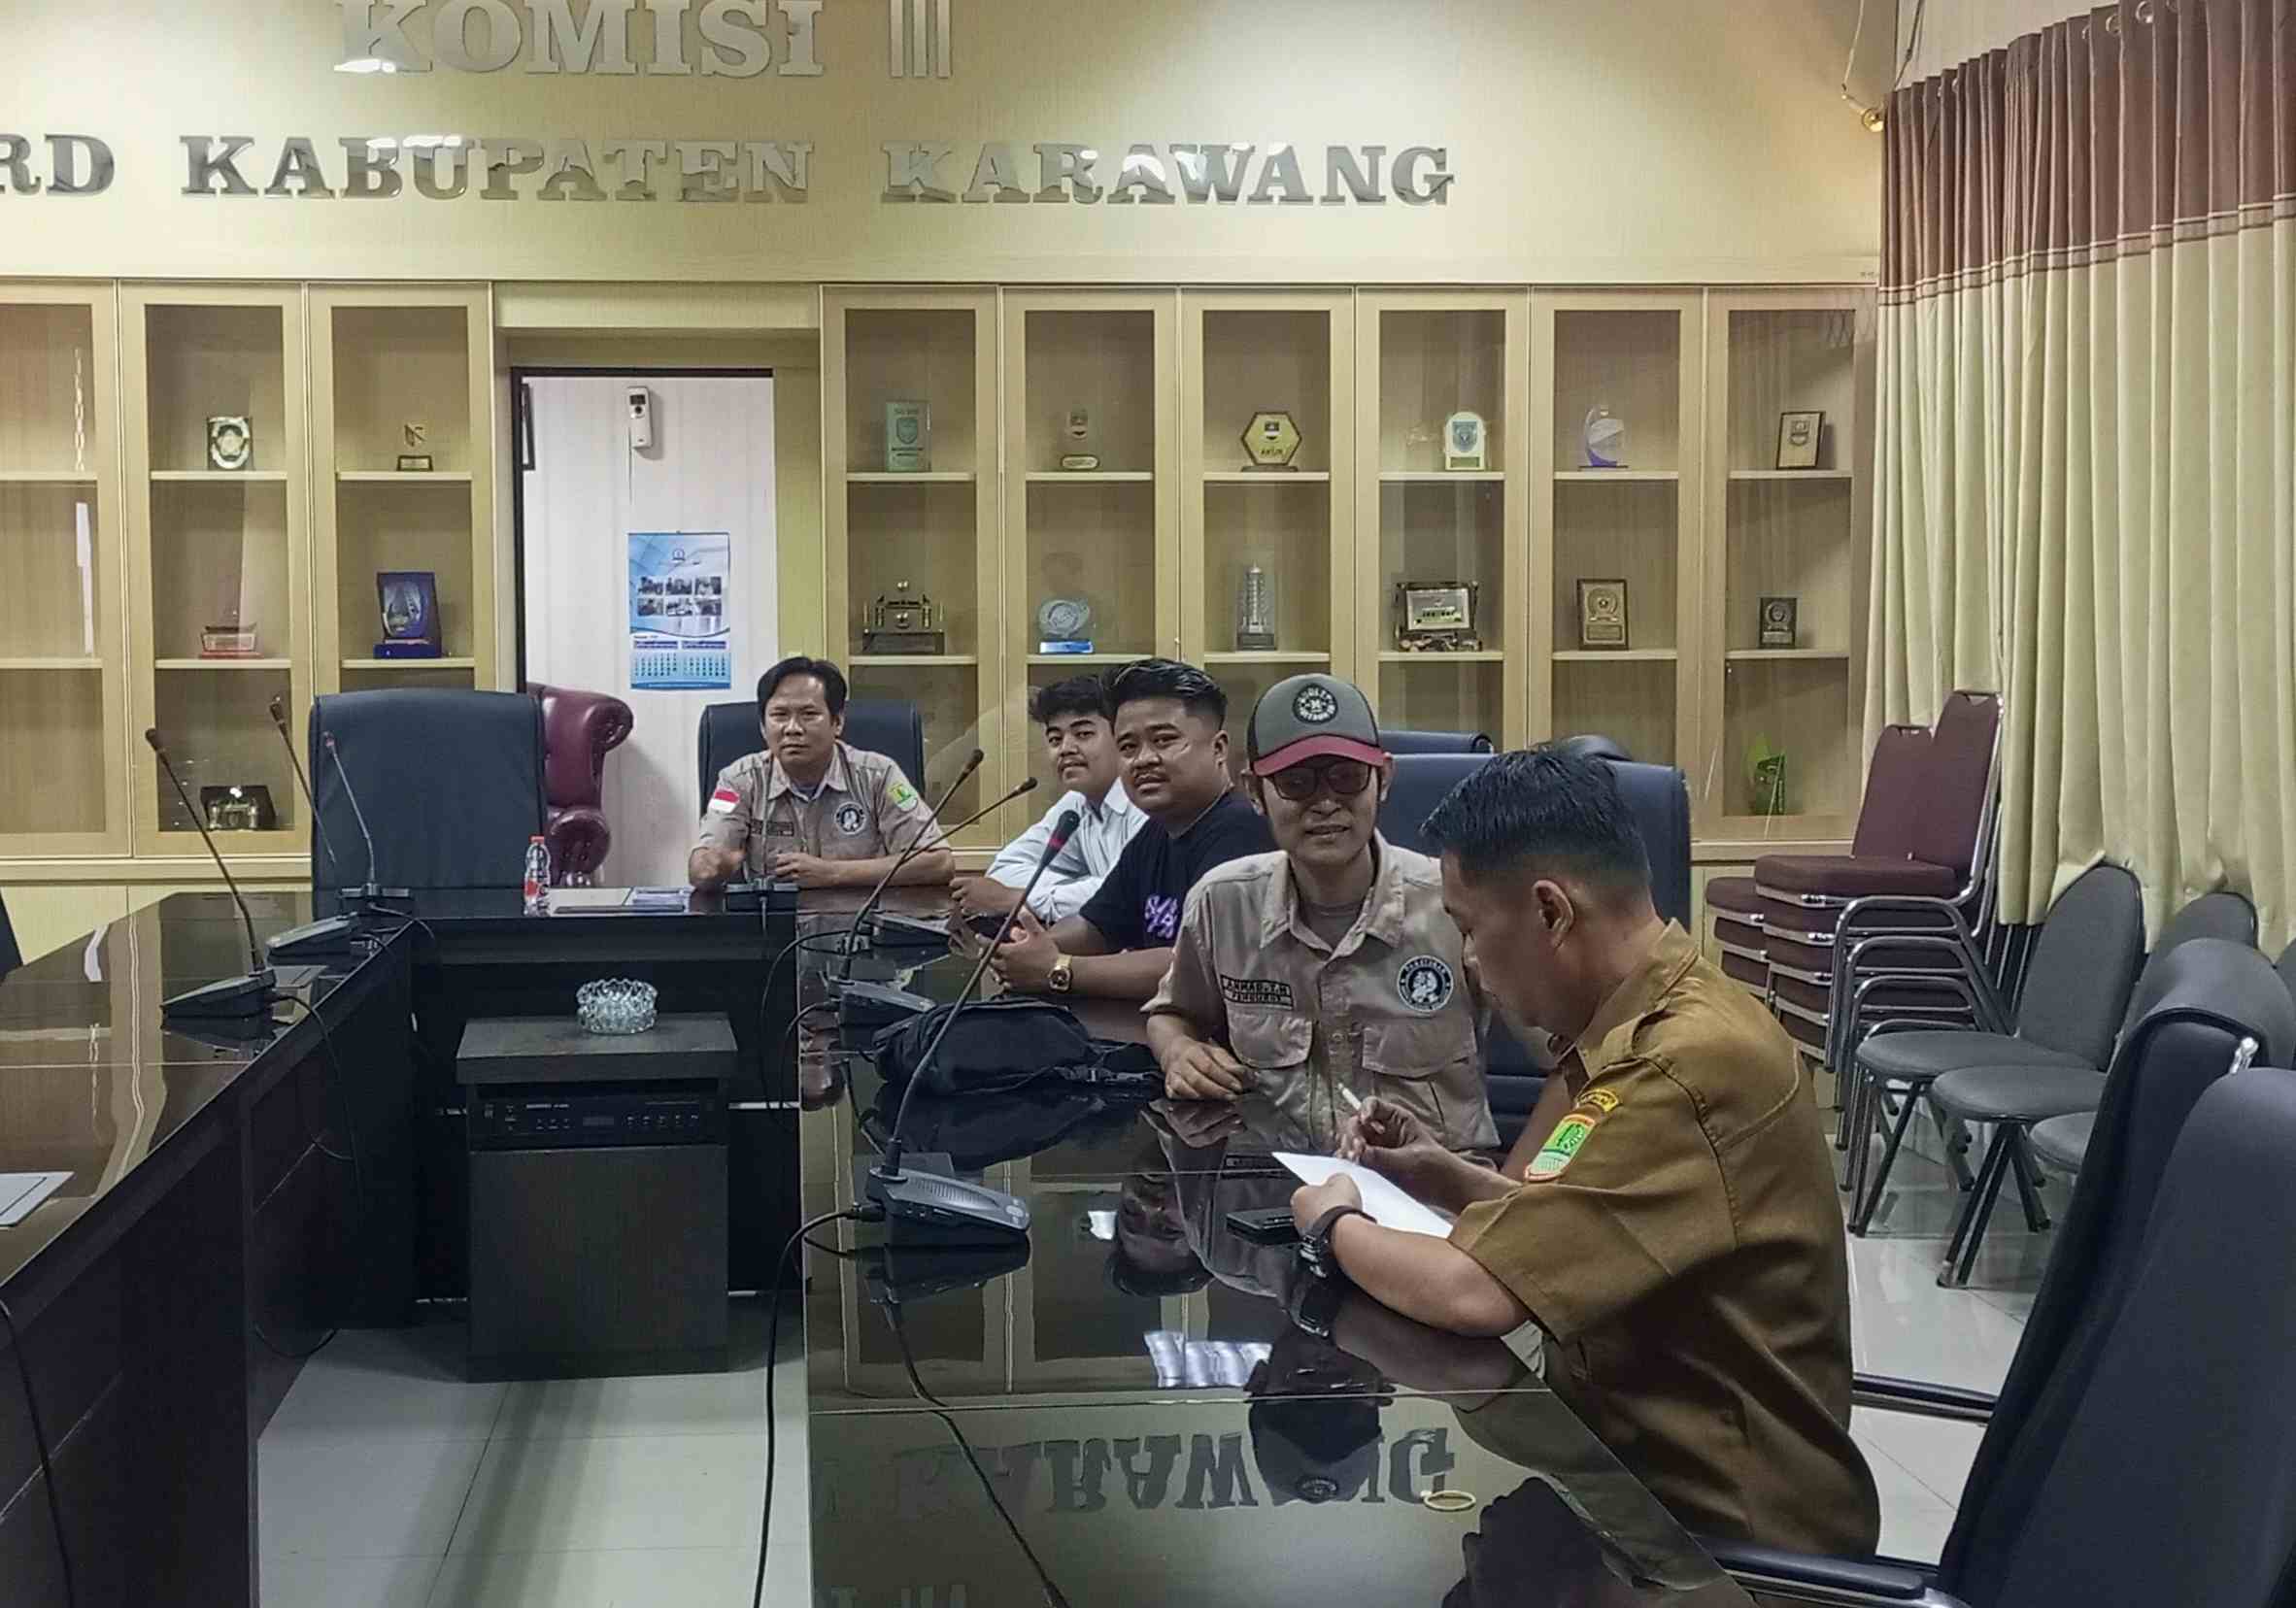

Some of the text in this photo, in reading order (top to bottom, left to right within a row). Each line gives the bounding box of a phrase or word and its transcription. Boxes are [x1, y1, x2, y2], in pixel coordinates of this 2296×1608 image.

[336, 0, 824, 79] KOMISI
[180, 134, 815, 203] KABUPATEN
[880, 142, 1455, 206] KARAWANG
